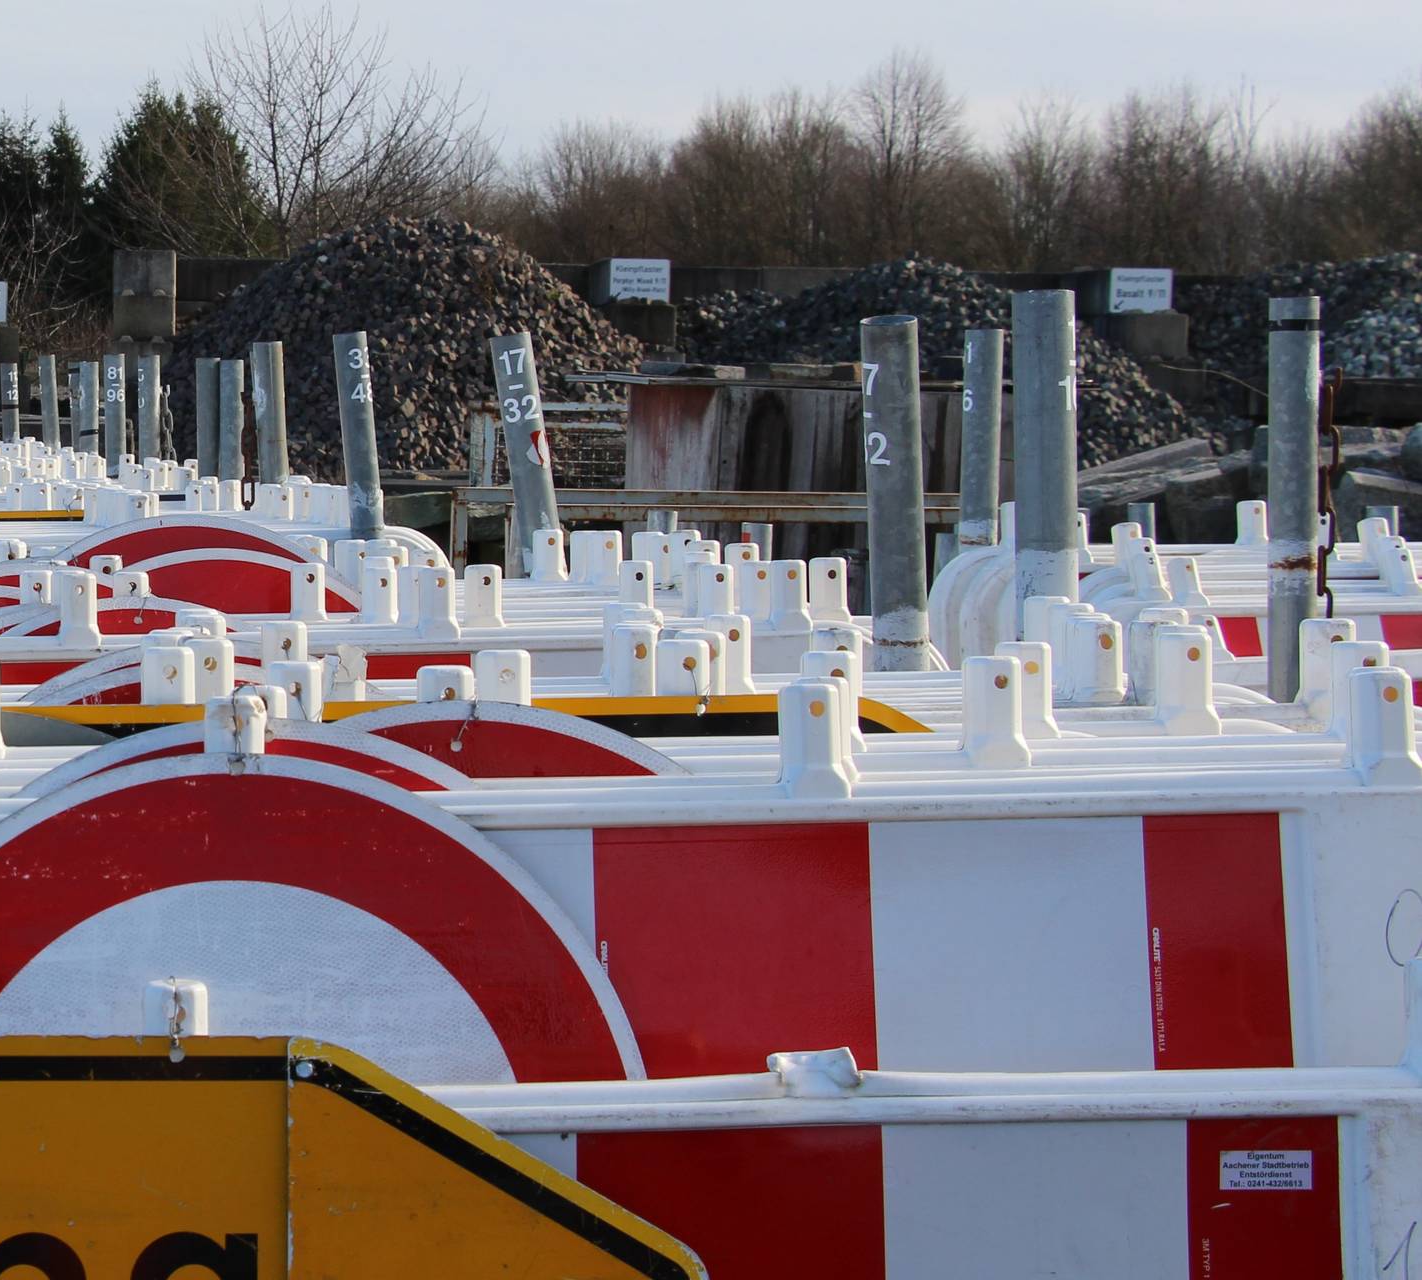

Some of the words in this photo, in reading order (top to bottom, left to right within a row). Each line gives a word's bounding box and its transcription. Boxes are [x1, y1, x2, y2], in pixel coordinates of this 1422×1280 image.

[1116, 288, 1144, 298] Basalt
[1148, 289, 1167, 298] 9/11
[499, 348, 526, 376] 17
[107, 366, 122, 380] 81
[106, 389, 125, 403] 96
[962, 389, 973, 412] 6
[503, 394, 540, 423] 32
[1247, 1152, 1285, 1161] Eigentum
[1239, 1170, 1293, 1178] Entstördienst
[1229, 1180, 1246, 1188] Tel.:
